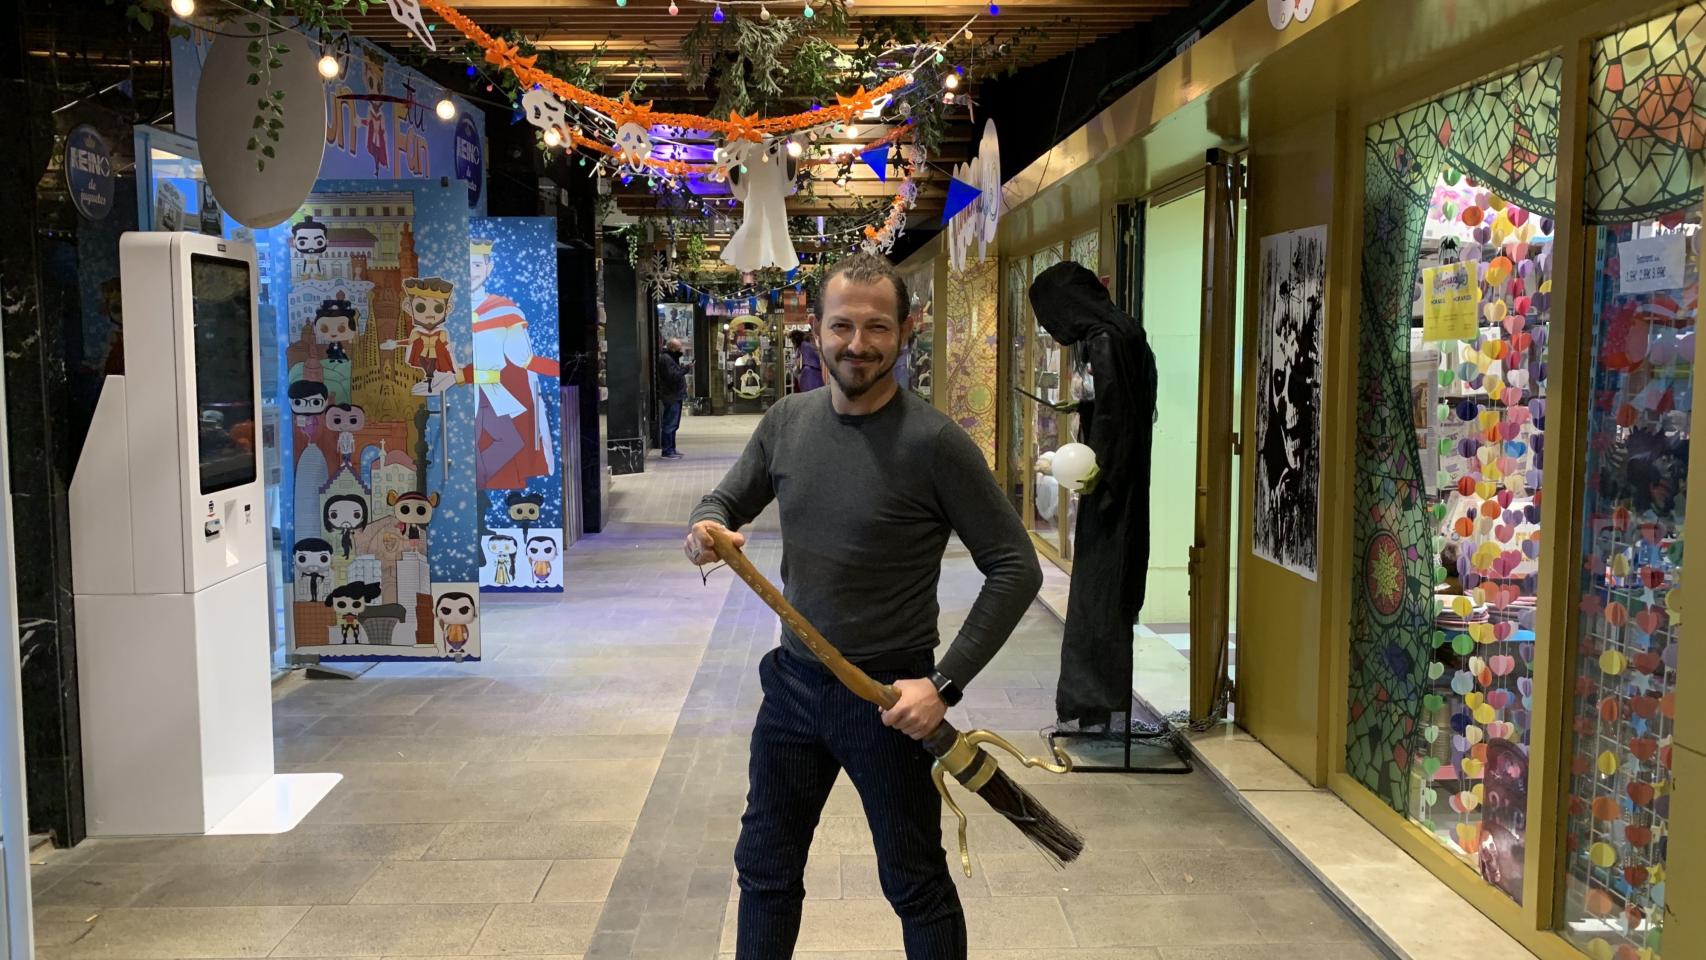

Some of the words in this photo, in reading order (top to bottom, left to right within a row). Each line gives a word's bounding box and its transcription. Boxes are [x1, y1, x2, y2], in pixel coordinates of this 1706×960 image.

[70, 146, 111, 177] REINO
[456, 136, 480, 165] REINO
[88, 178, 97, 191] de
